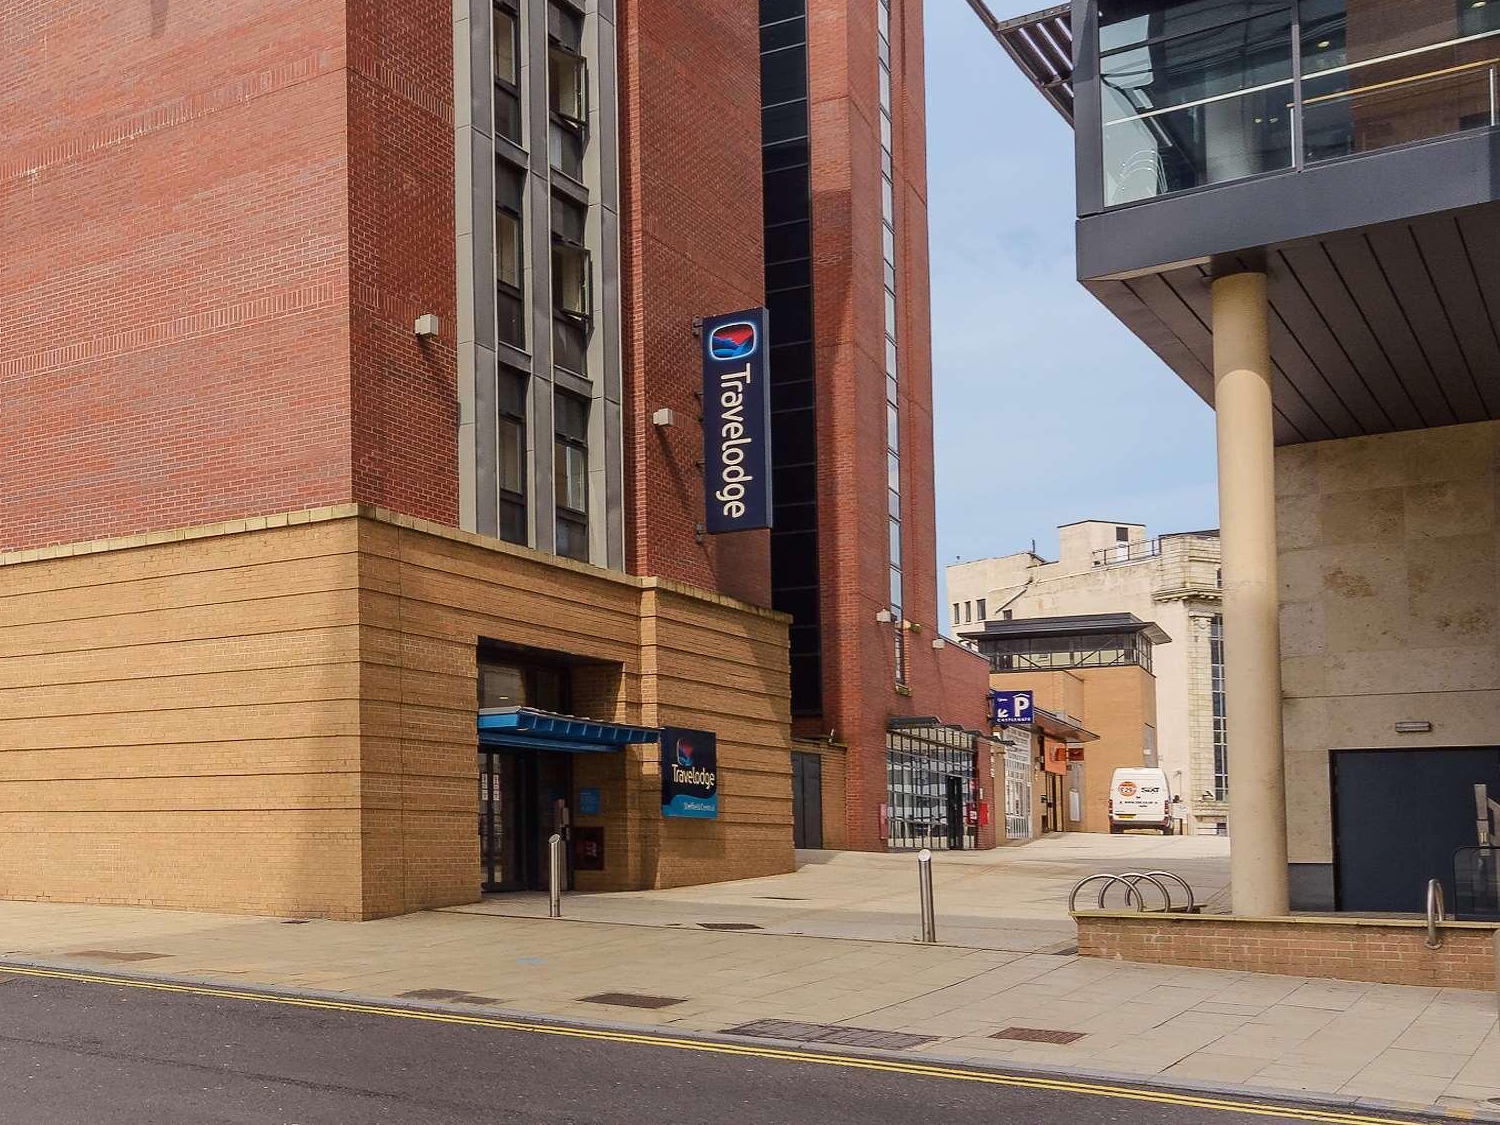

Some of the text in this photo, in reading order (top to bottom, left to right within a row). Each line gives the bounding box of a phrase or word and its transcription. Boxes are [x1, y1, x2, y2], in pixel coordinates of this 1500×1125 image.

[715, 362, 753, 519] Travelodge
[1014, 696, 1030, 717] P
[671, 763, 715, 790] Travelodge
